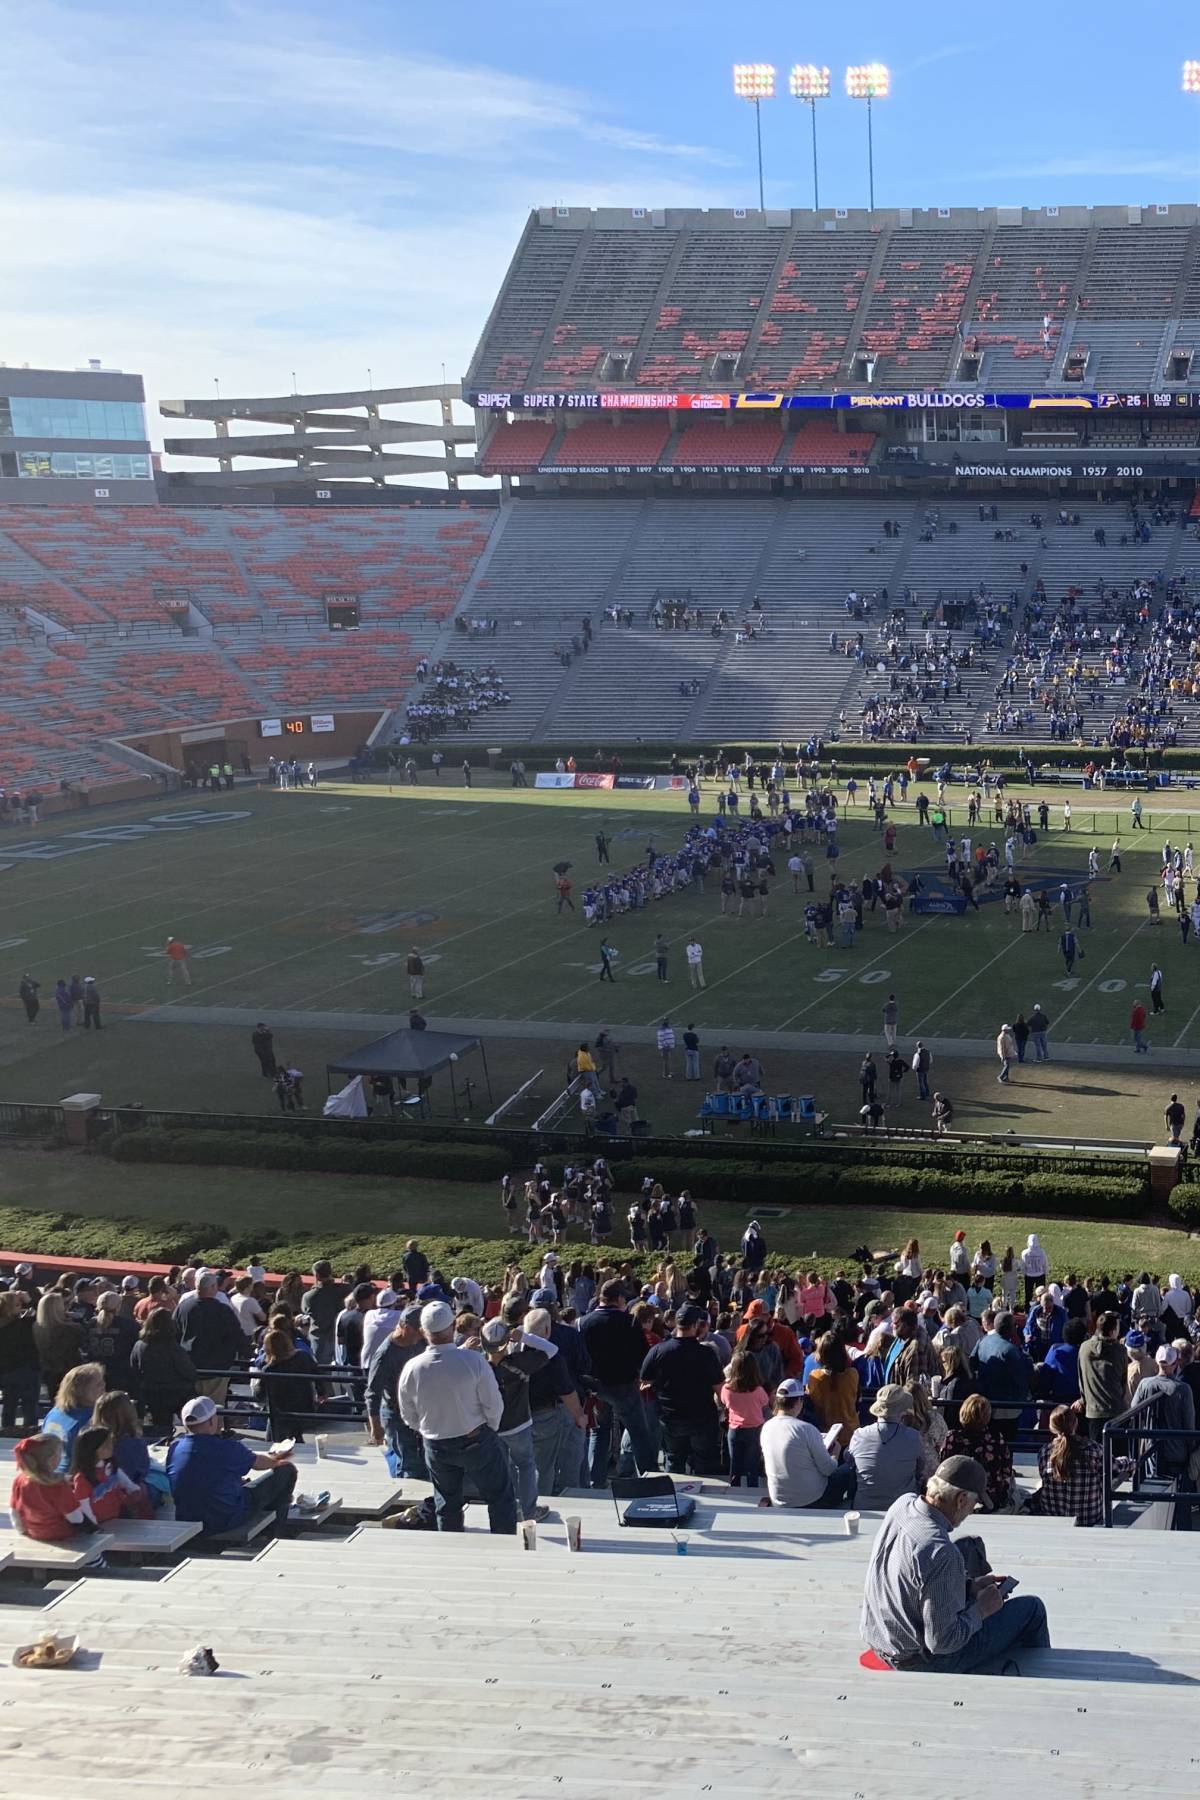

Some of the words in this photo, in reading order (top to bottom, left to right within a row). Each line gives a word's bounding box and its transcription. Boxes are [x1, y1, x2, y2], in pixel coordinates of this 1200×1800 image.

[523, 394, 555, 407] SUPER
[559, 394, 565, 407] 7
[567, 394, 598, 407] STATE
[601, 393, 678, 408] CHAMPIONSHIPS
[850, 395, 904, 407] PIEDMONT
[908, 393, 985, 408] BULLDOGS
[1127, 395, 1141, 407] 26
[1153, 393, 1171, 402] 0:00
[955, 466, 1007, 476] NATIONAL
[1010, 467, 1072, 476] CHAMPIONS
[1082, 467, 1107, 476] 1957
[1117, 467, 1142, 476] 2010
[286, 721, 303, 733] 40
[813, 968, 891, 984] 50
[1052, 977, 1128, 993] 40
